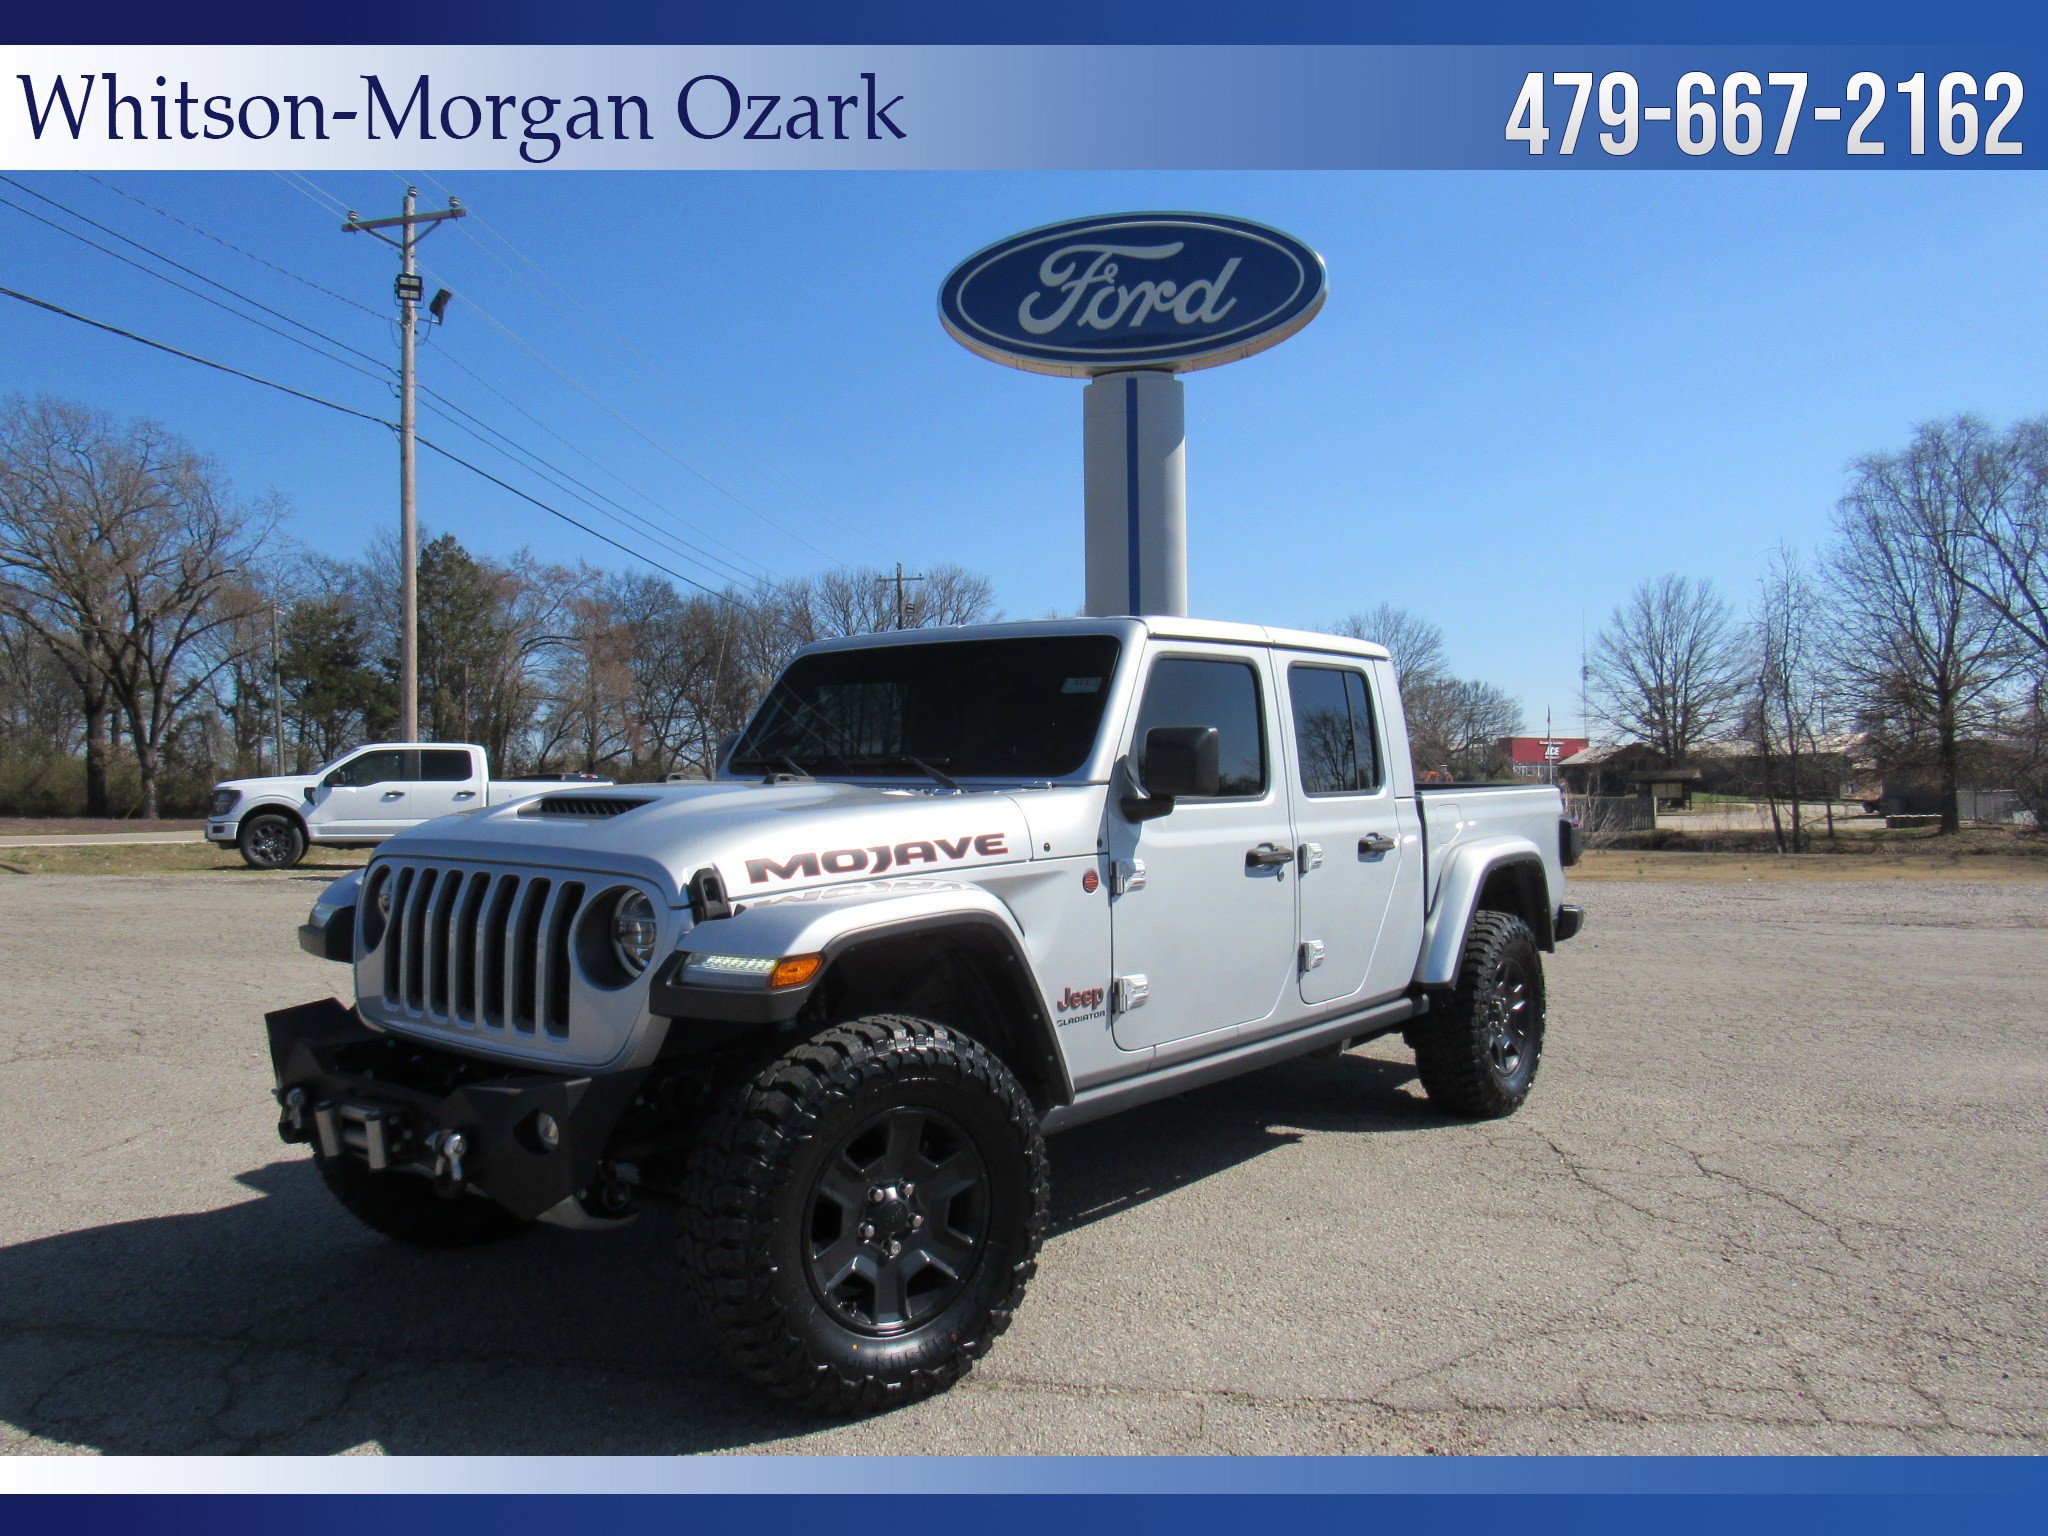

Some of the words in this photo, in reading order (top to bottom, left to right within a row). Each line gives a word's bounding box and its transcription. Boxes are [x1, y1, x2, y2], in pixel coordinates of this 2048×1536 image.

[1018, 241, 1242, 334] Ford
[1544, 746, 1560, 756] ACE
[746, 833, 1009, 883] MOJAVE
[1057, 986, 1104, 1011] Jeep
[1057, 1010, 1106, 1027] GLADIATOR
